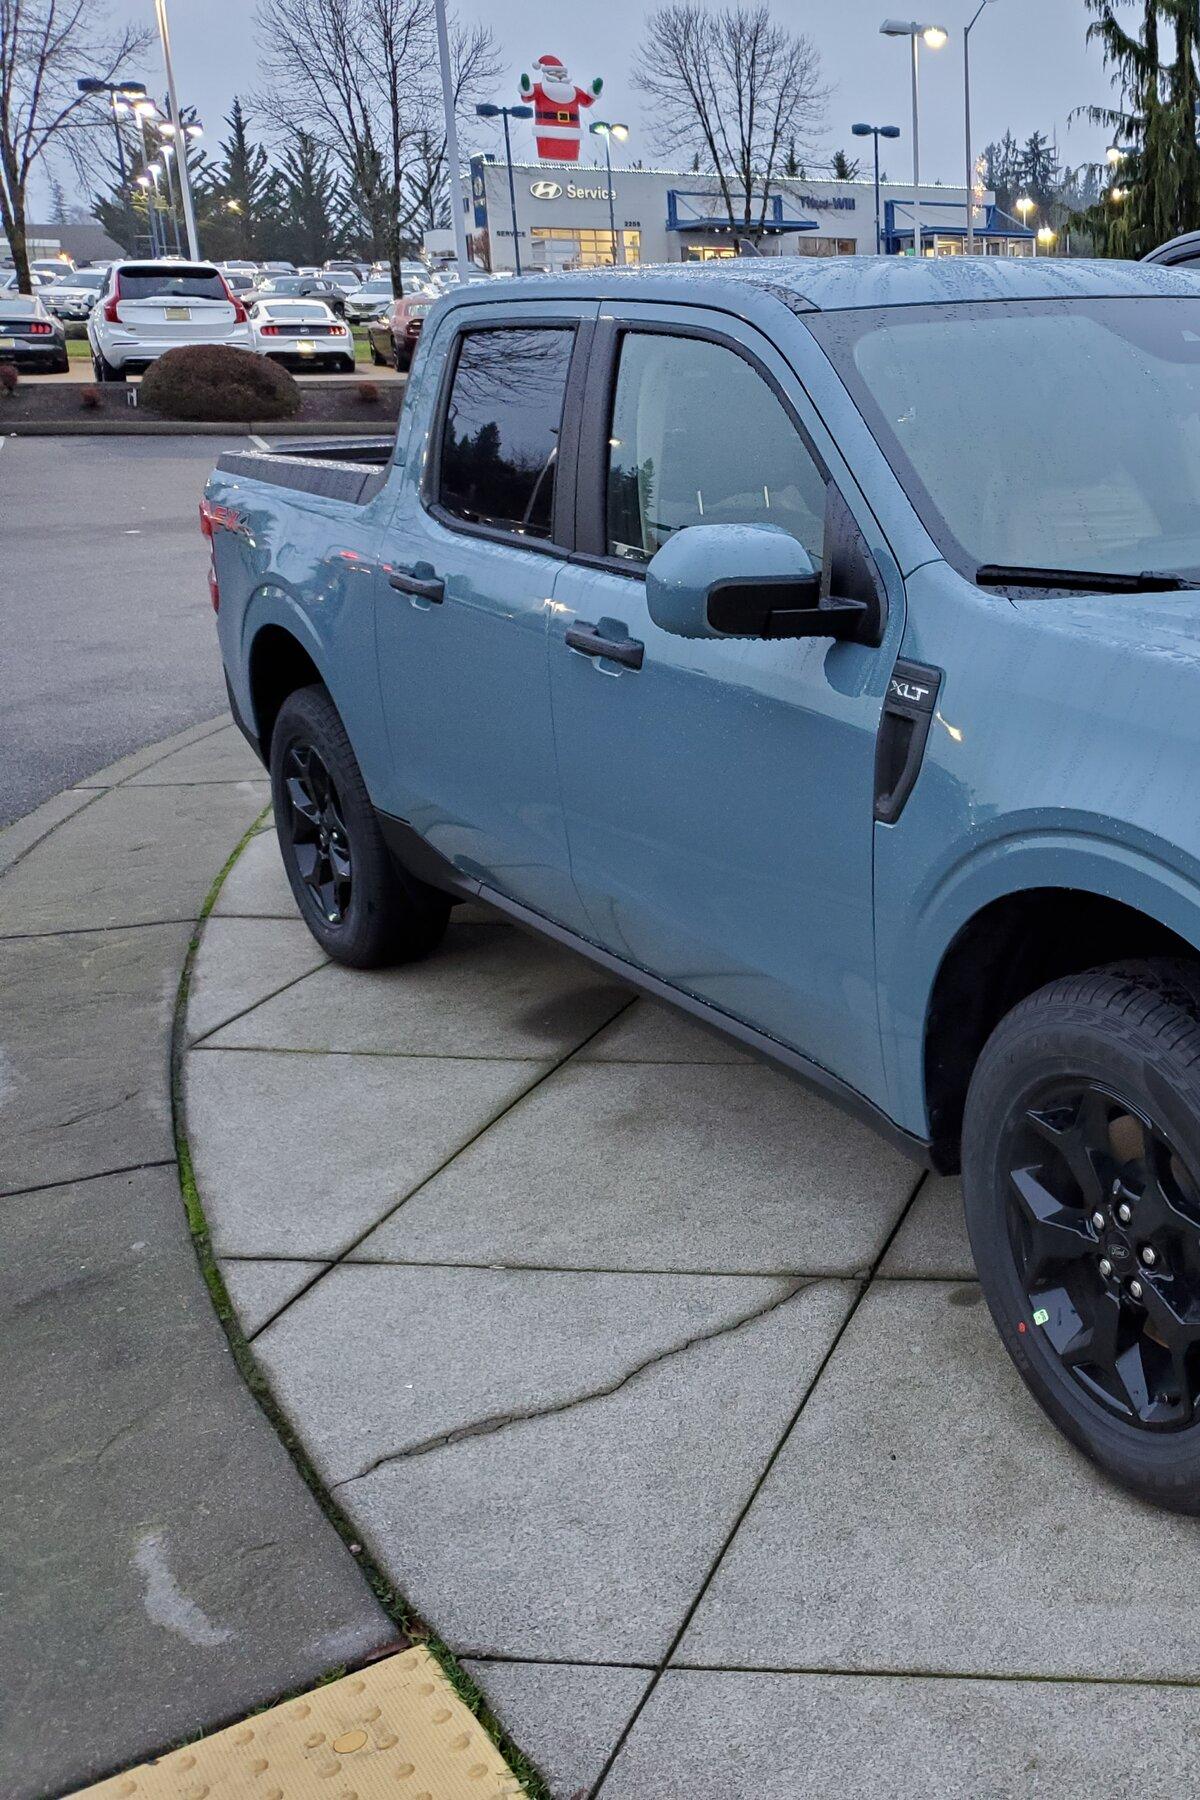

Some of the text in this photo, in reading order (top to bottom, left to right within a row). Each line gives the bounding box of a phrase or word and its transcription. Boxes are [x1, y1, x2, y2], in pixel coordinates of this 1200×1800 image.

[567, 184, 617, 200] Service
[496, 230, 526, 238] SERVCE
[890, 680, 930, 701] XLT
